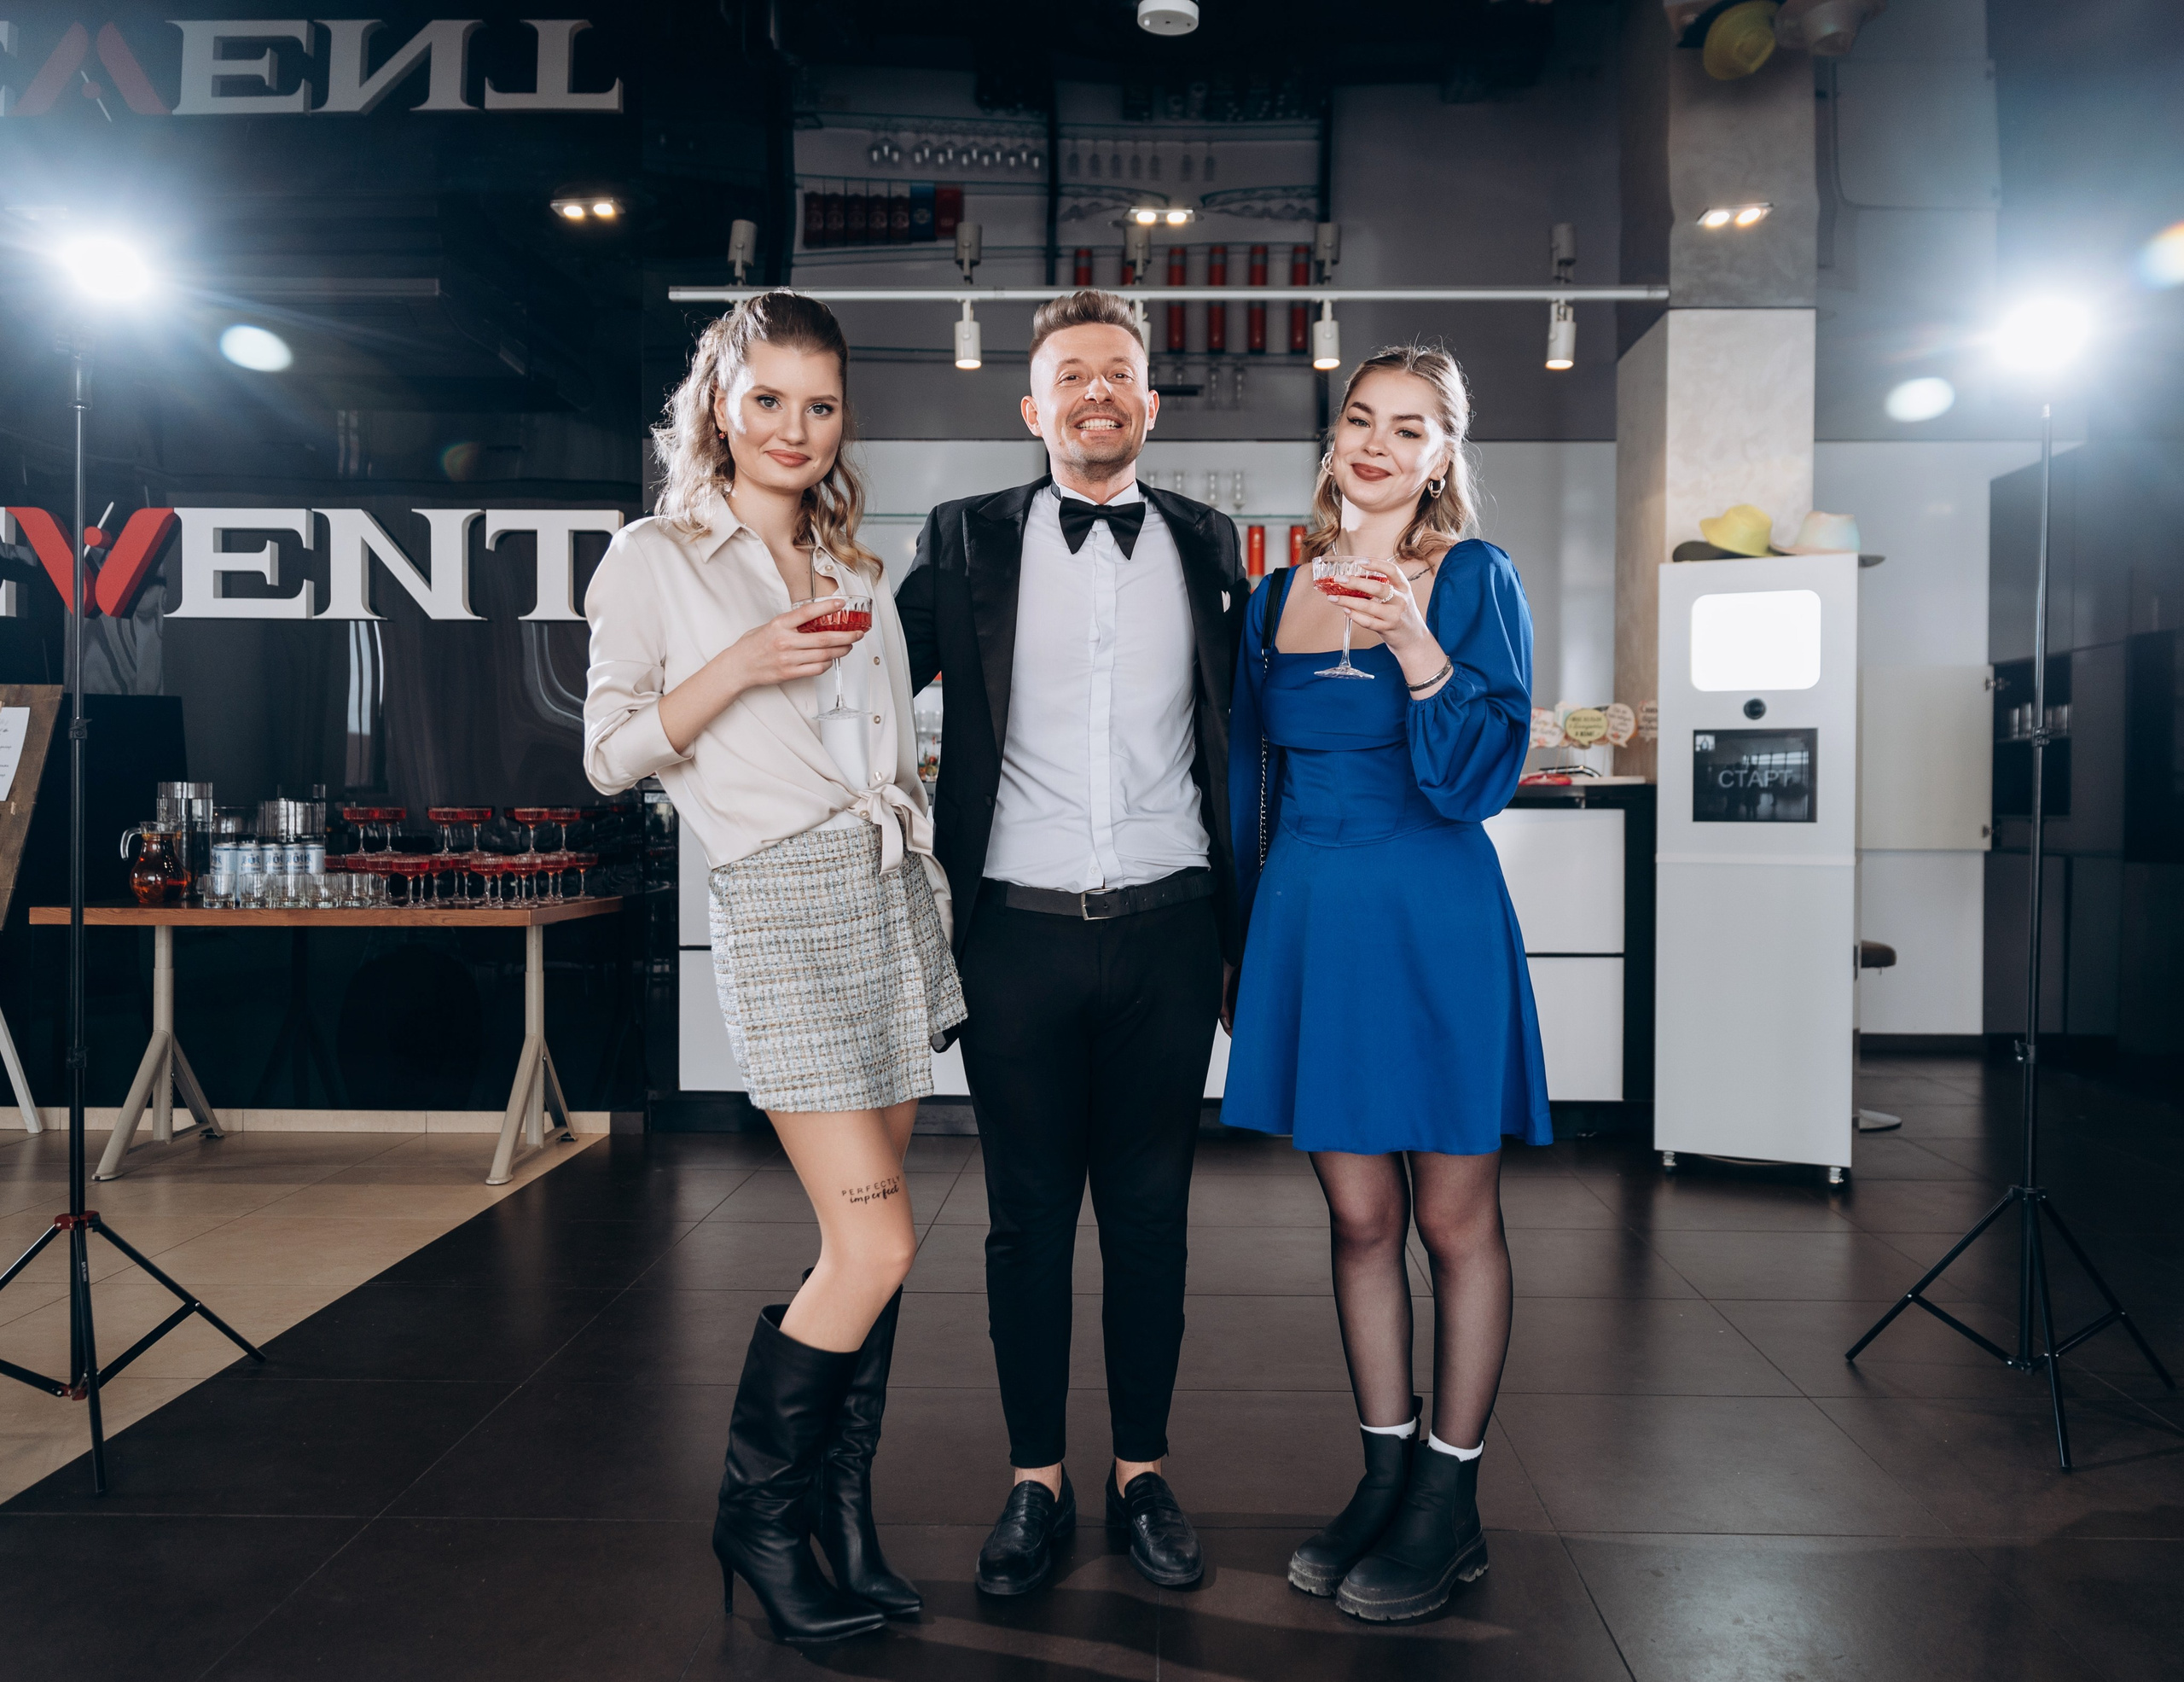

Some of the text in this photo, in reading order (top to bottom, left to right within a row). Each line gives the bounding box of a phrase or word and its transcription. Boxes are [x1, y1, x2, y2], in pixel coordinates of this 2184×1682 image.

[0, 506, 624, 620] VENT
[1718, 770, 1793, 789] СТАРТ
[841, 1175, 900, 1196] PERFECTLY
[850, 1184, 899, 1204] imperfect
